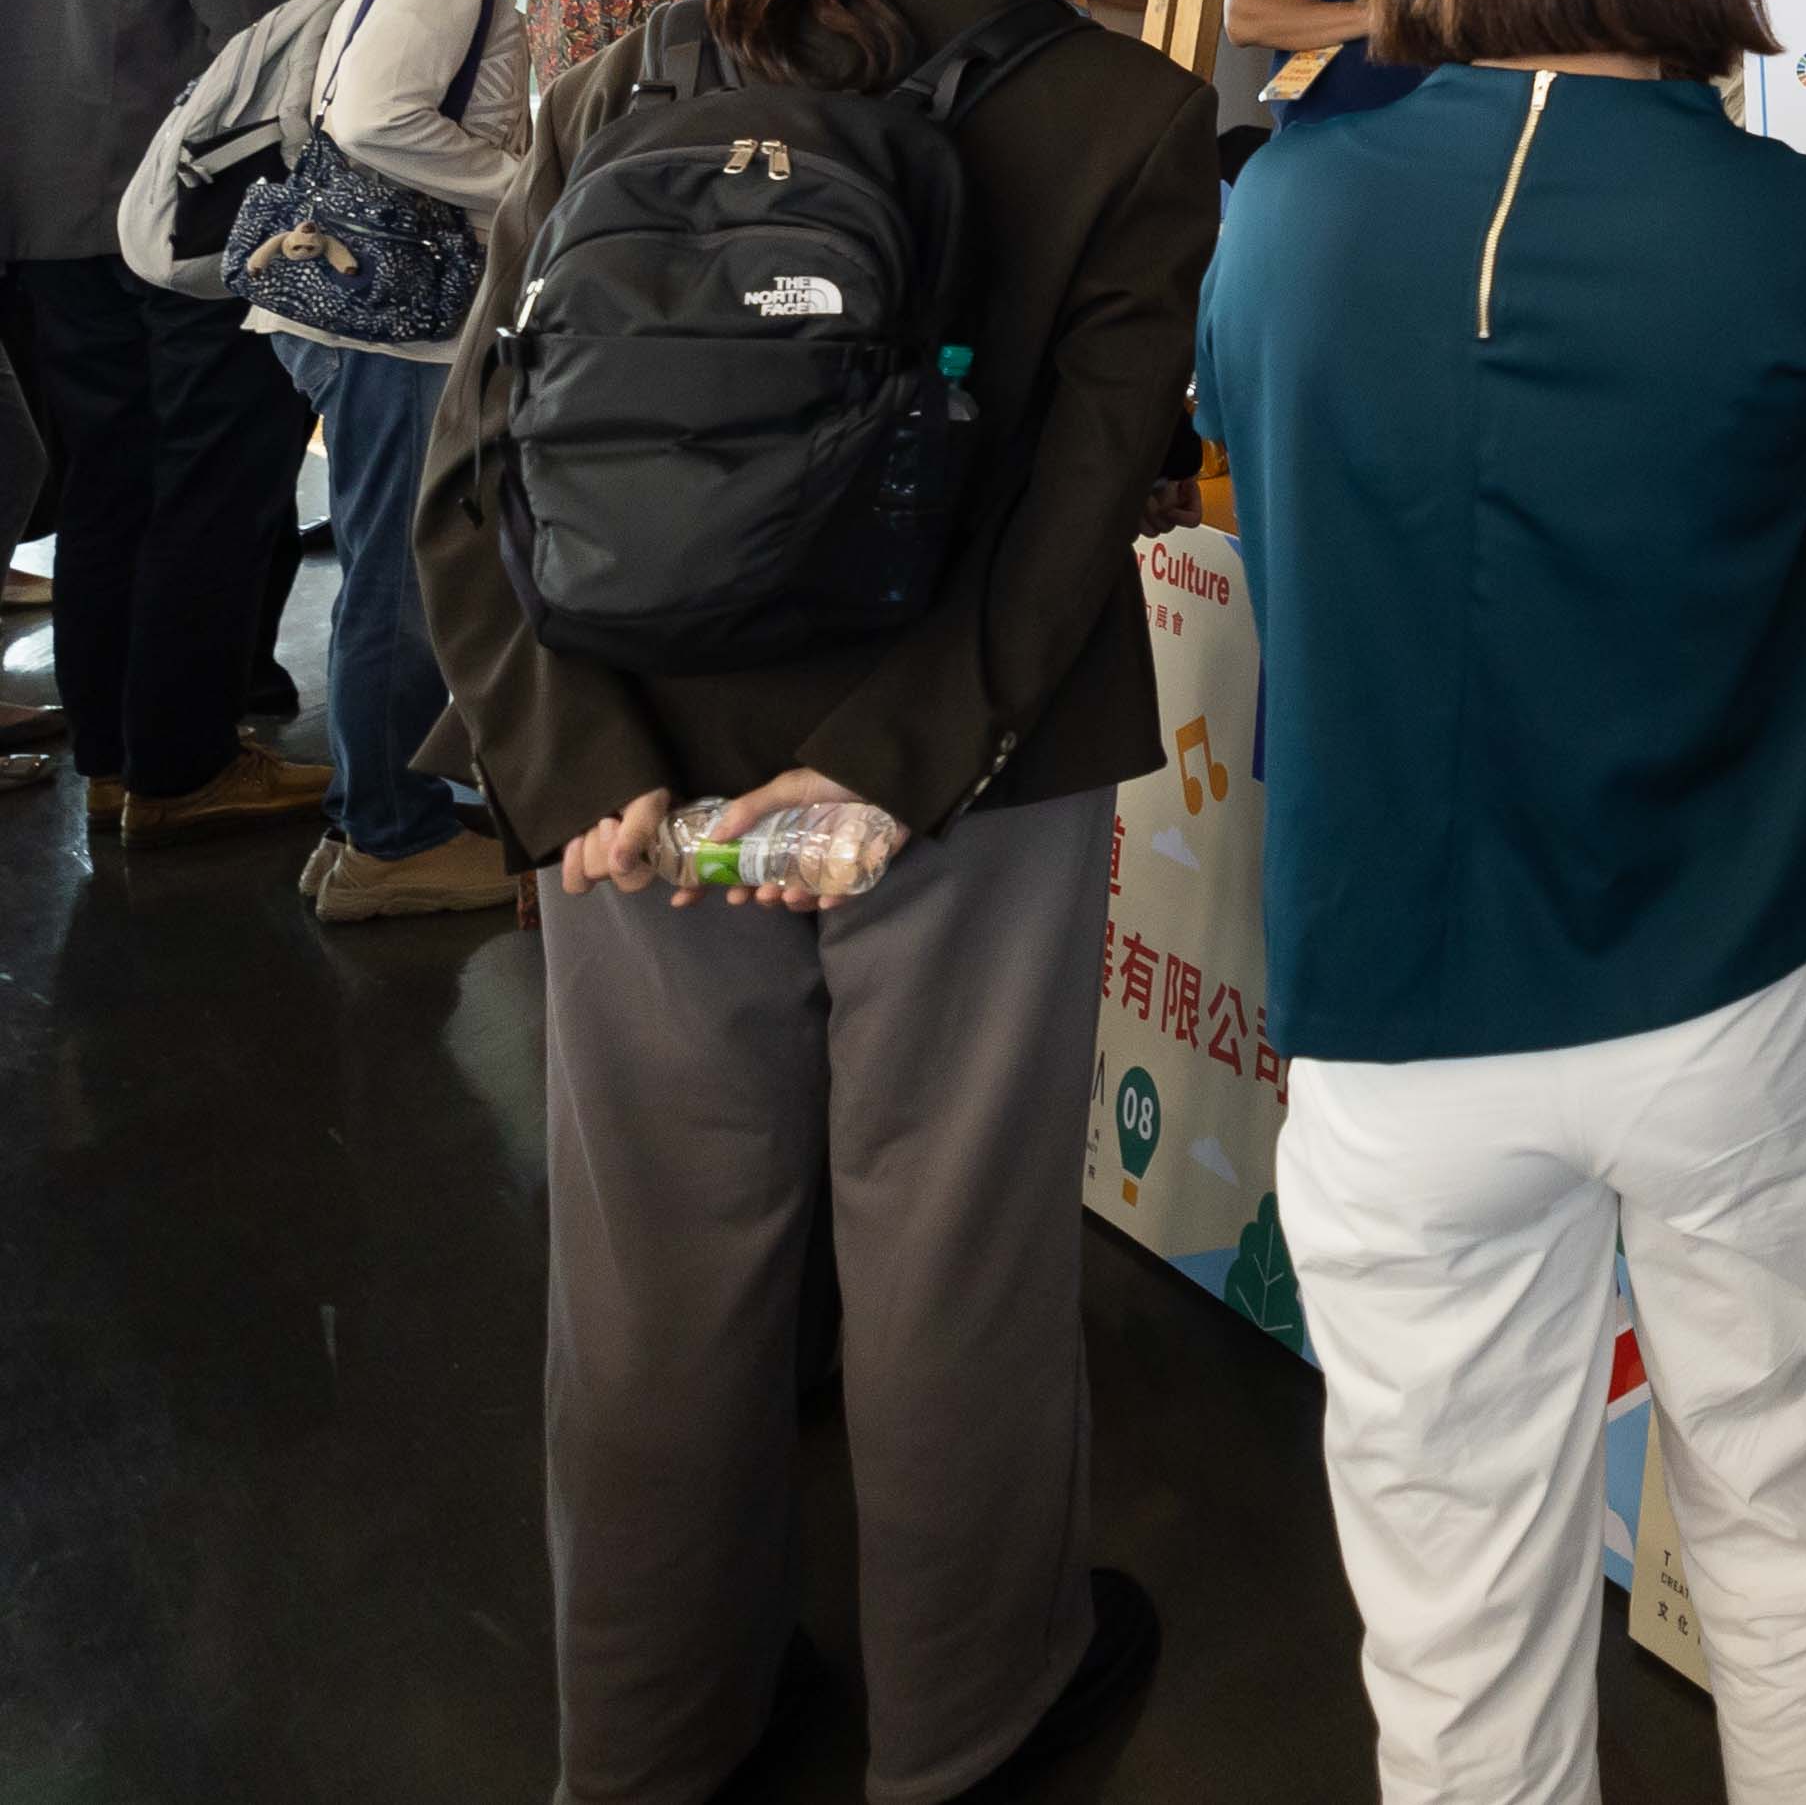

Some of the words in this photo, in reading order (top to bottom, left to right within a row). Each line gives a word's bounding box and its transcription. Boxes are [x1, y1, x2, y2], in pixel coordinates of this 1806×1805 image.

[773, 276, 811, 290] THE
[744, 290, 810, 305] NORTH
[760, 302, 811, 316] FACE
[1152, 542, 1230, 606] Culture
[1123, 1086, 1154, 1141] 08
